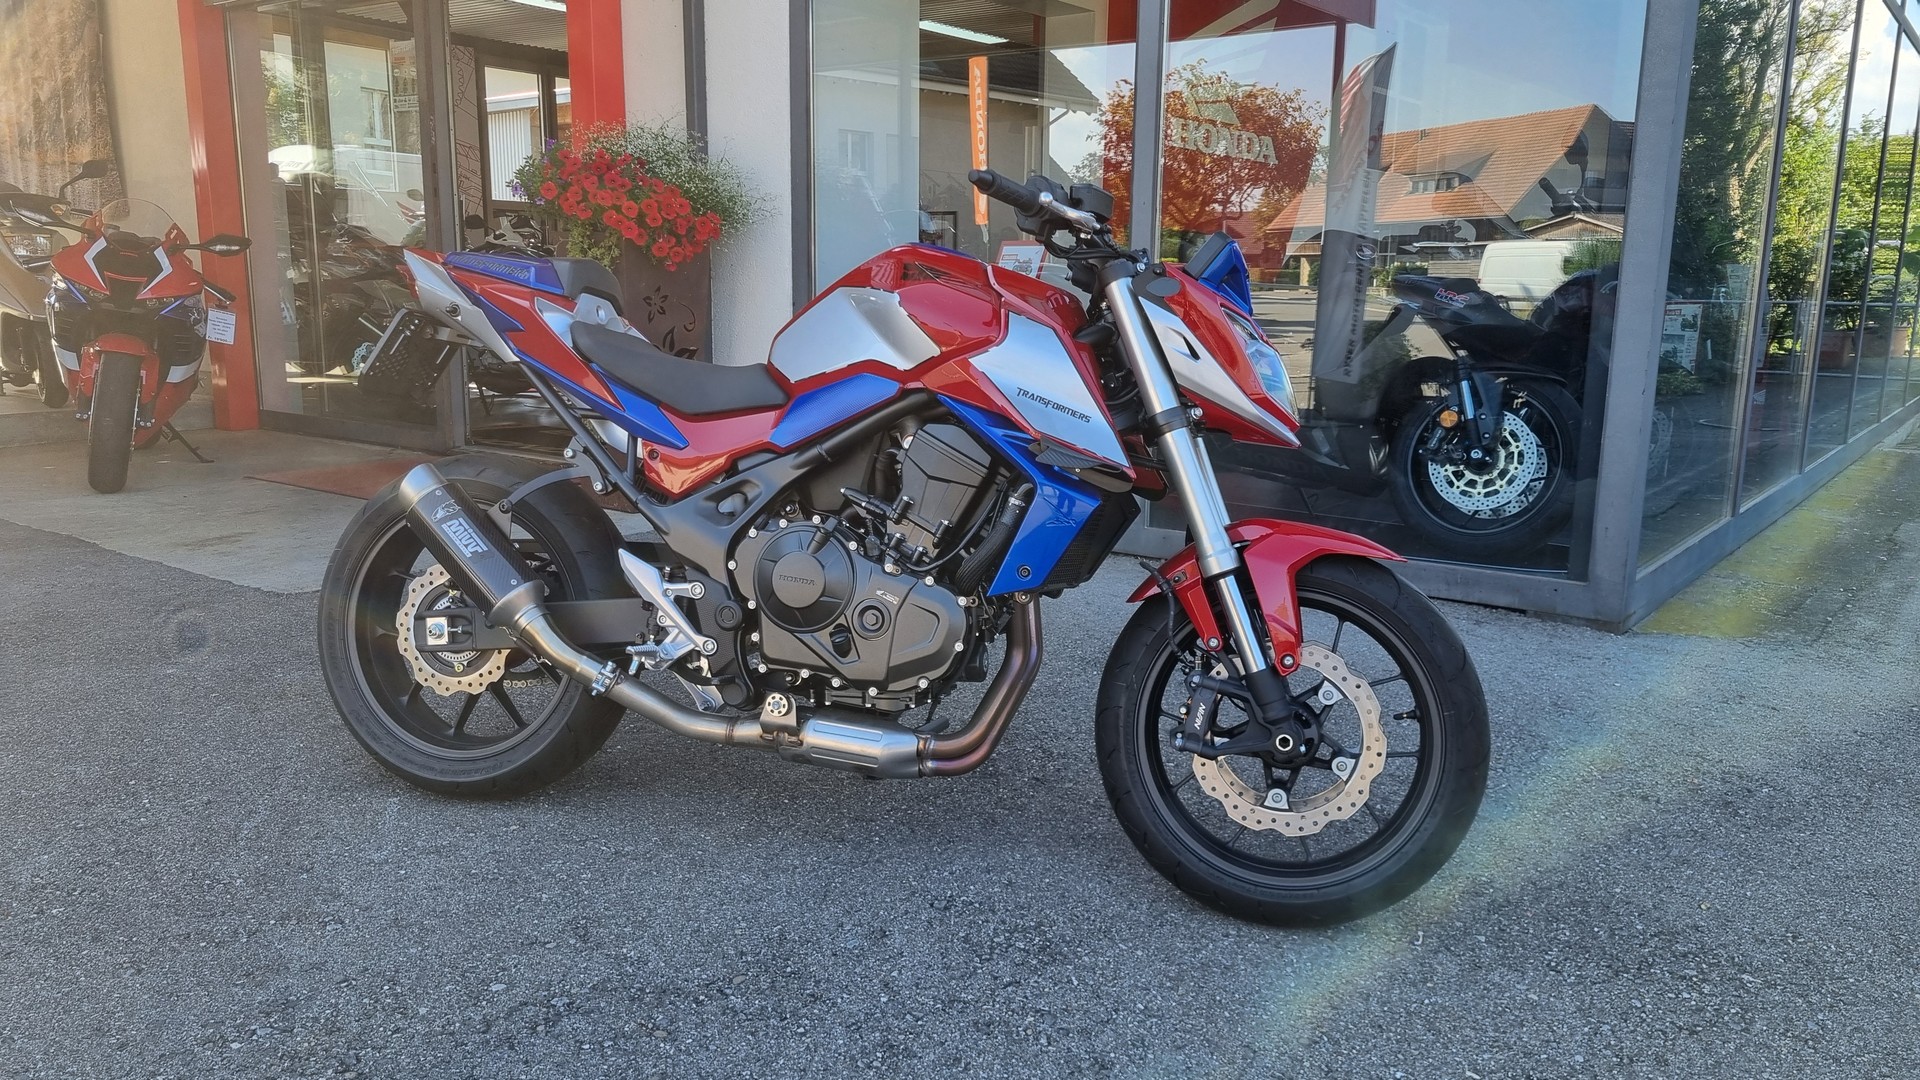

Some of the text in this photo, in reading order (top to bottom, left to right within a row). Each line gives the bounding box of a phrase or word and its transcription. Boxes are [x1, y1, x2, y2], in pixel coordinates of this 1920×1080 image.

[1171, 117, 1279, 165] HONDA
[1016, 386, 1092, 423] TRANSFORMERS
[779, 574, 816, 586] HONDA
